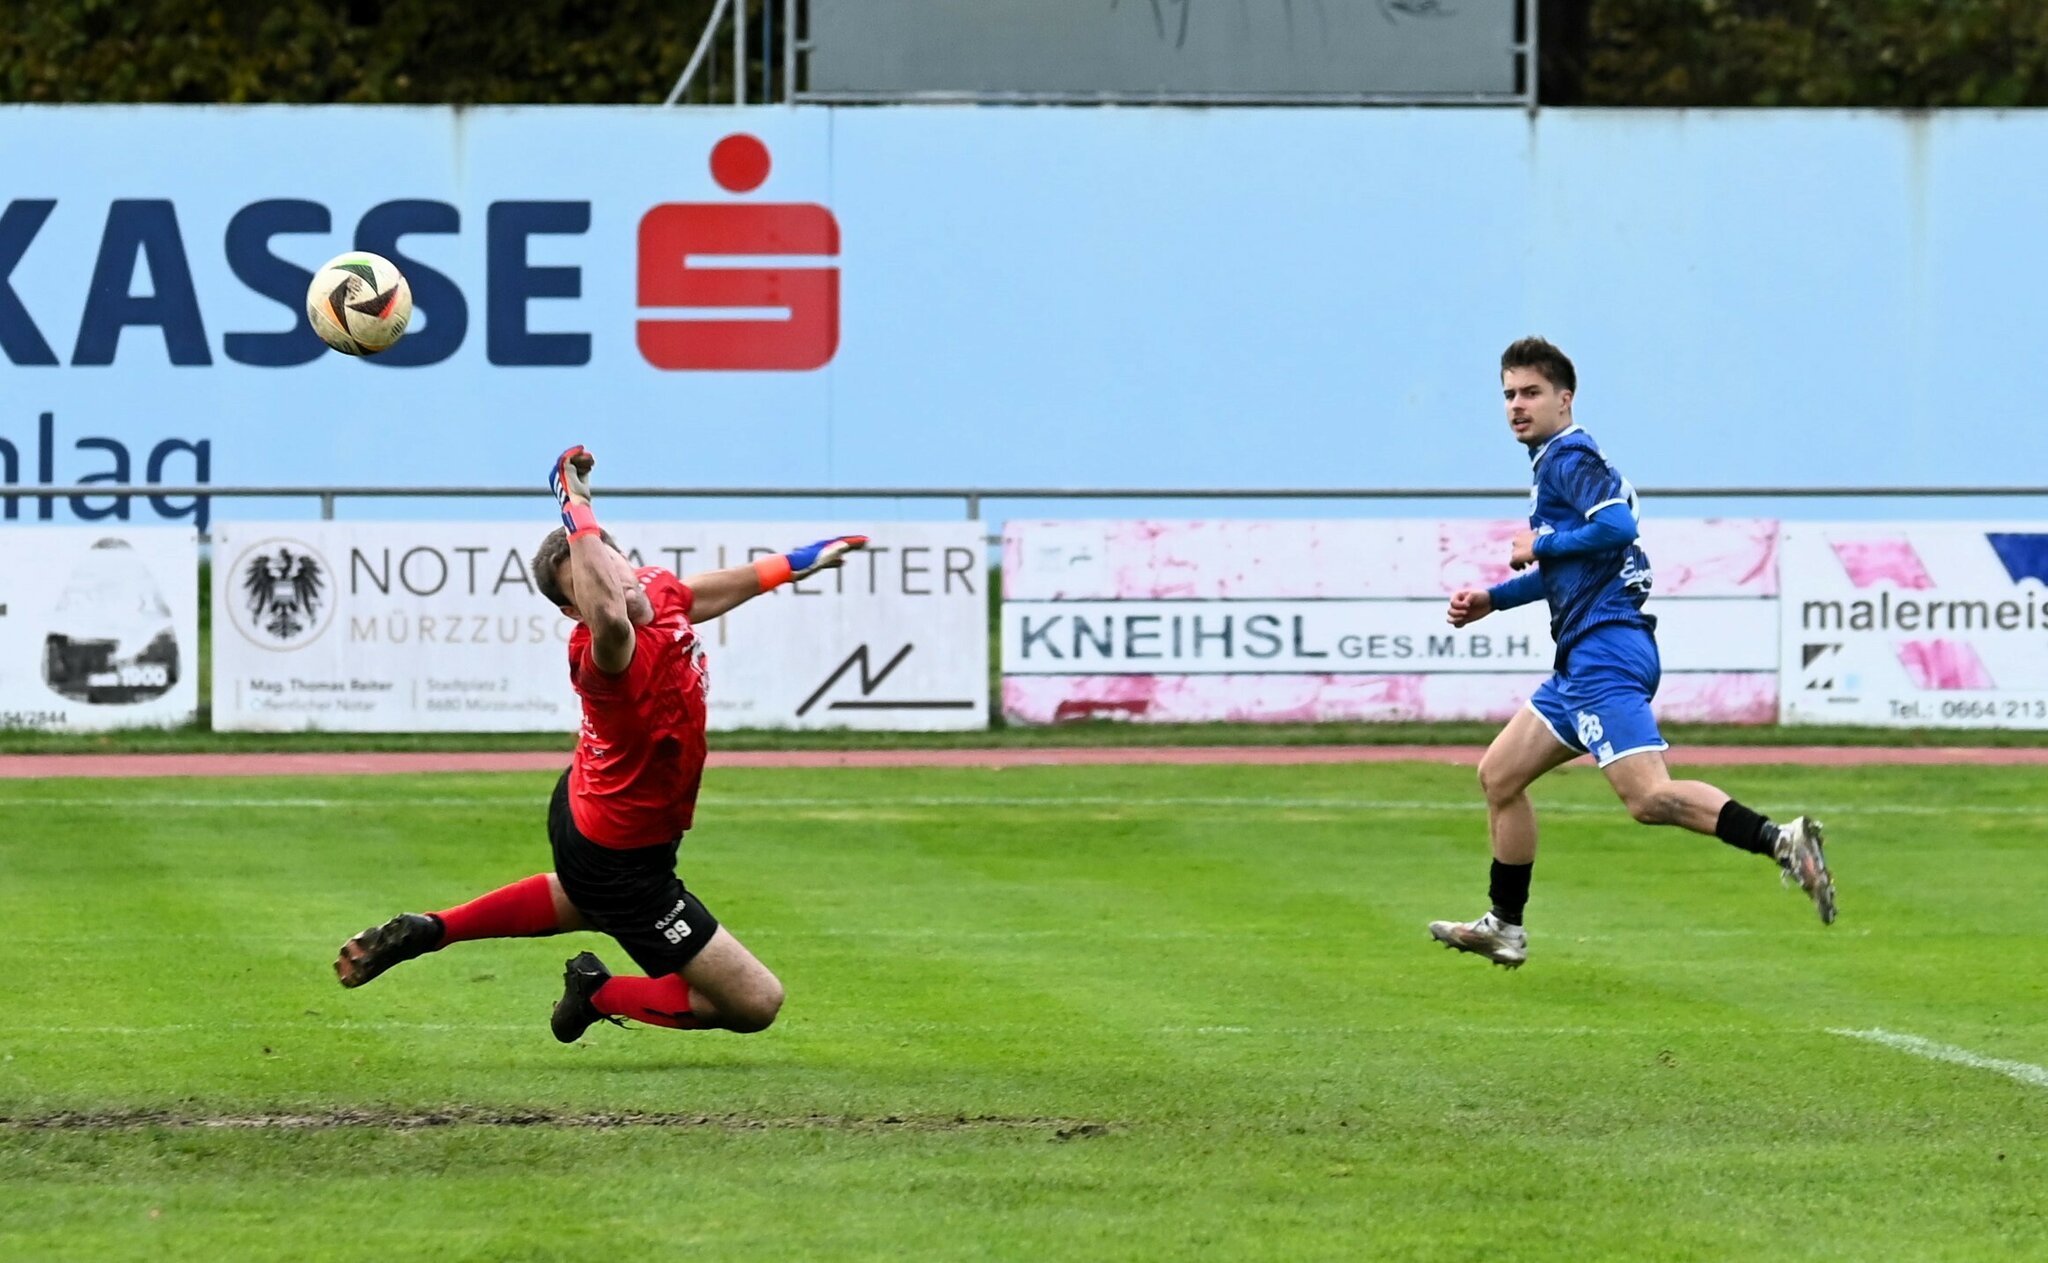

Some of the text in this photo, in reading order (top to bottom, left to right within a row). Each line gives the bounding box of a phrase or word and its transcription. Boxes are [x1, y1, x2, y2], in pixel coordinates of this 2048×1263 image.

[351, 546, 696, 597] NOTAT
[1021, 614, 1329, 659] KNEIHSL
[289, 677, 345, 692] Thomas
[663, 919, 692, 945] 99
